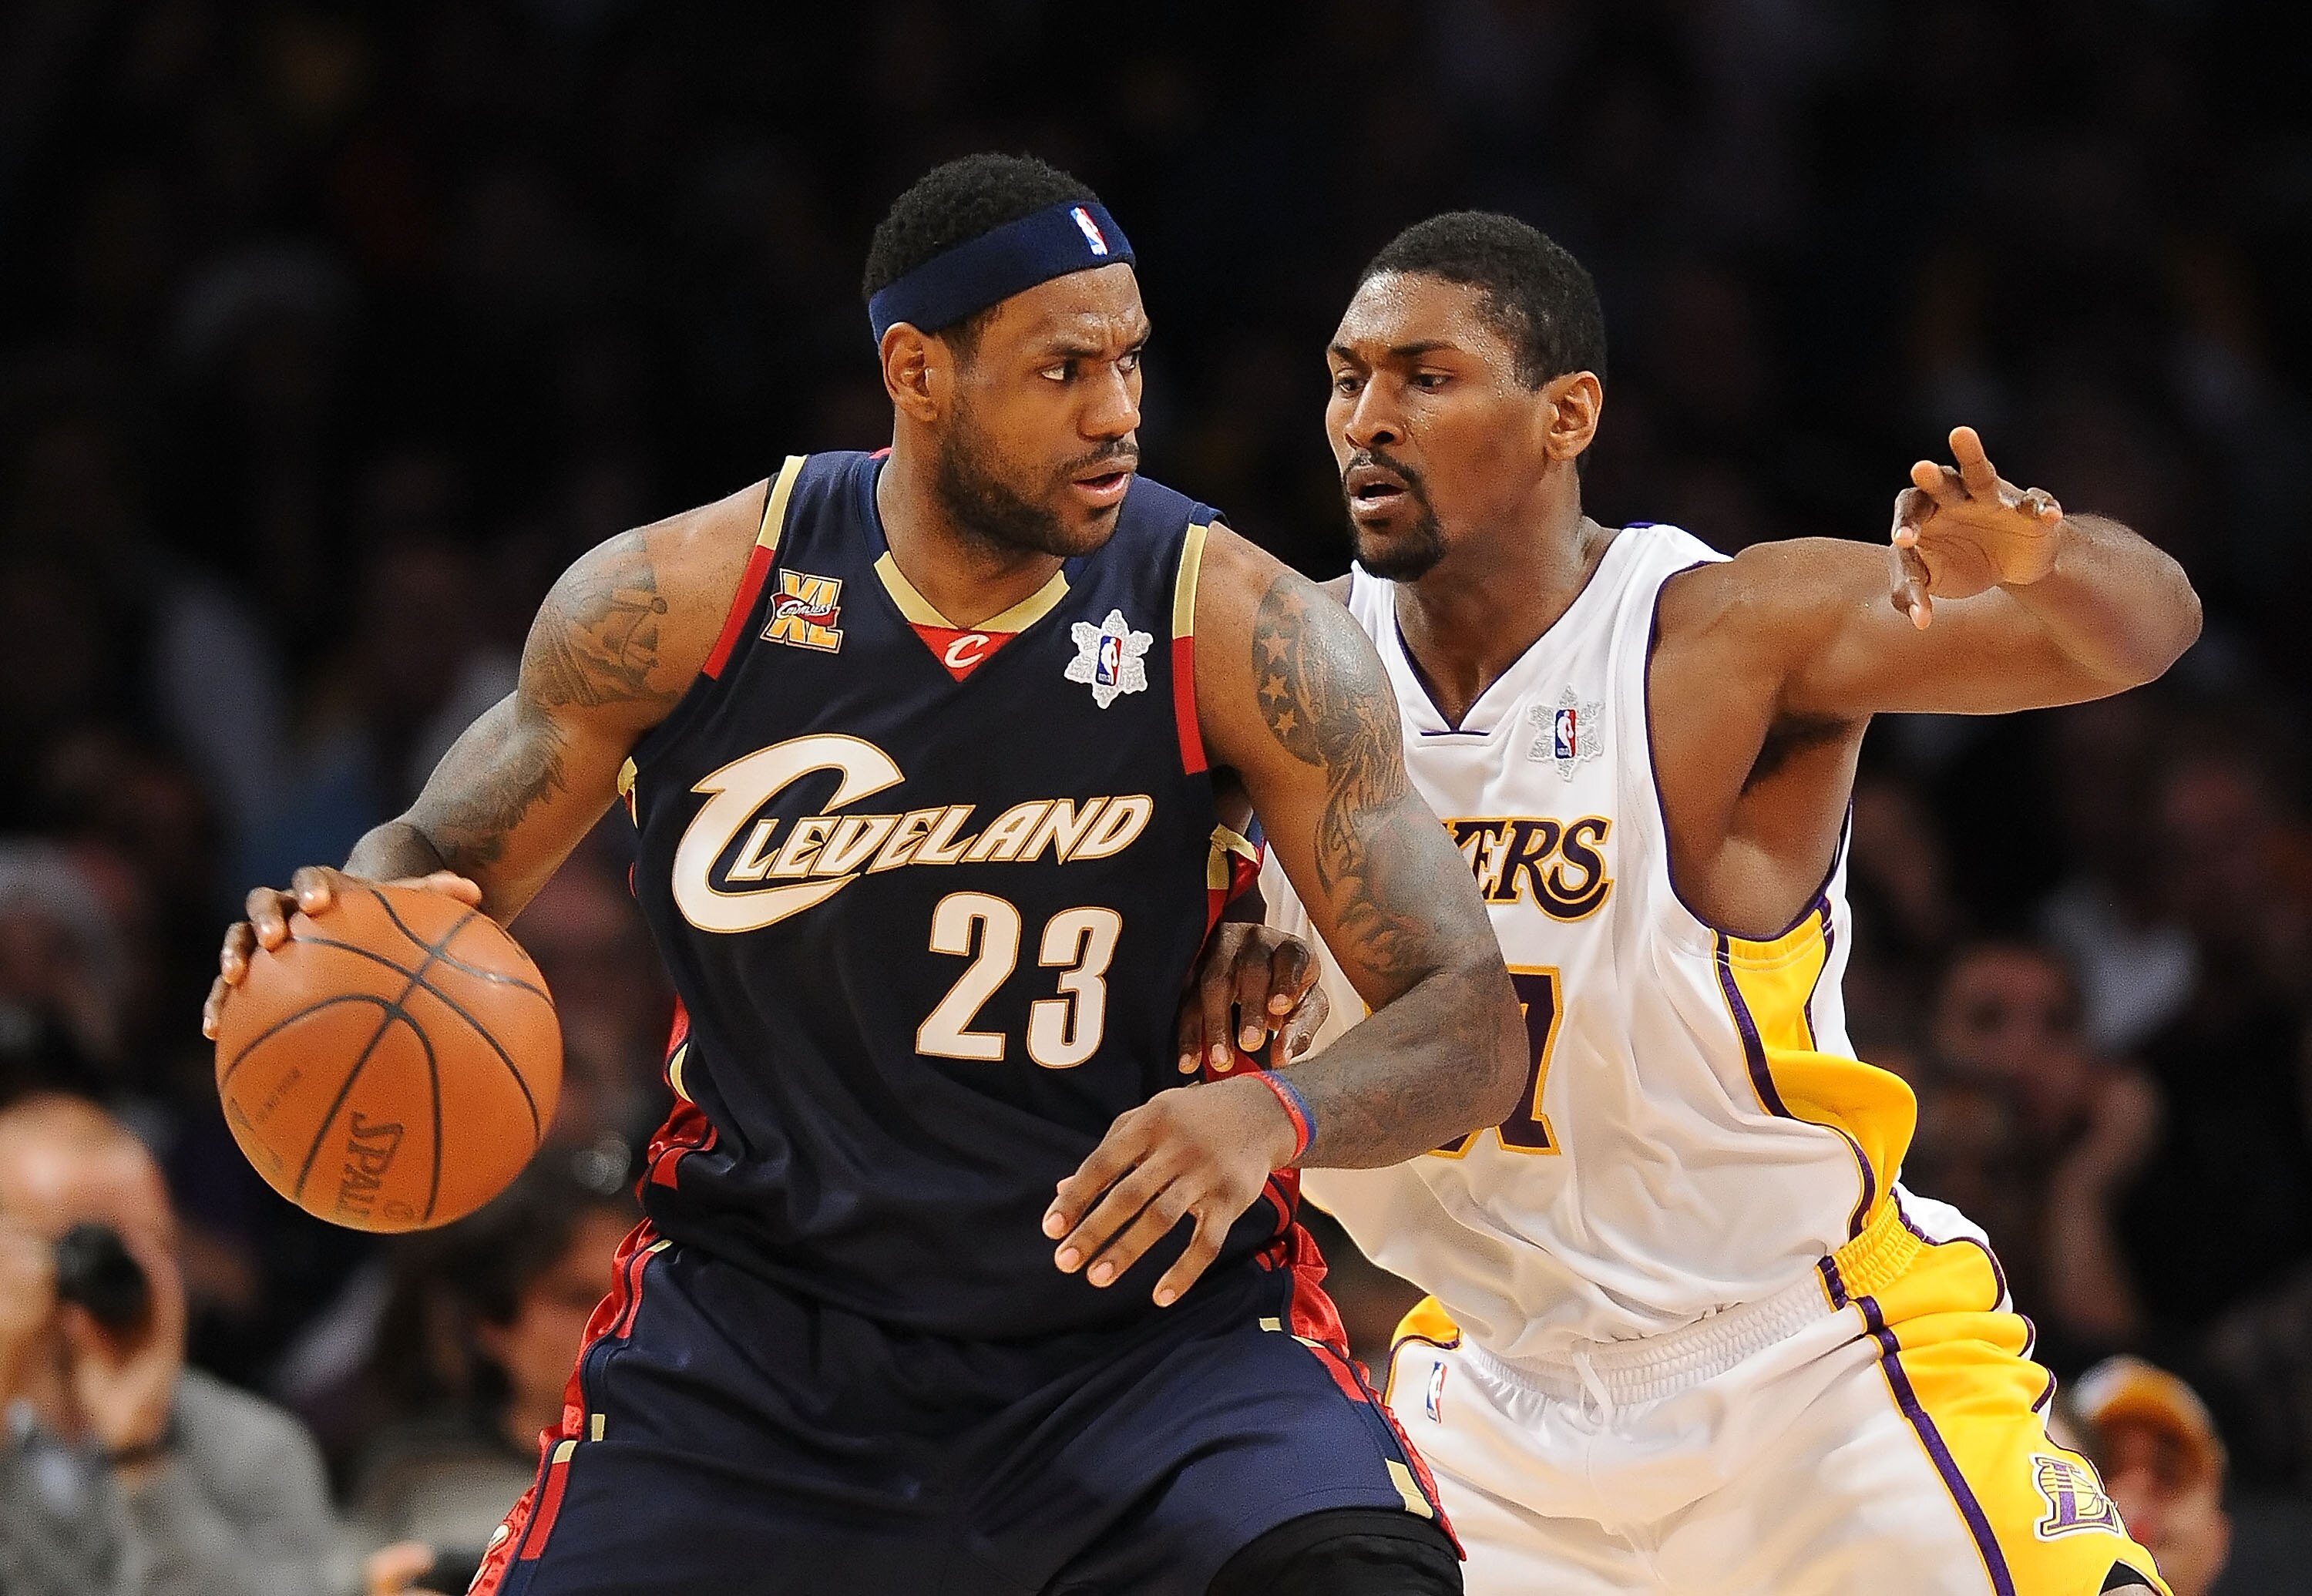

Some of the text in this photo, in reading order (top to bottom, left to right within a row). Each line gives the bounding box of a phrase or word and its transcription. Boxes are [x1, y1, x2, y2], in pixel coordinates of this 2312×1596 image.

[944, 634, 990, 668] C
[672, 734, 1154, 933] CLEVELAND
[1440, 814, 1615, 923] ERS
[916, 892, 1122, 1068] 23
[1427, 965, 1563, 1159] 7
